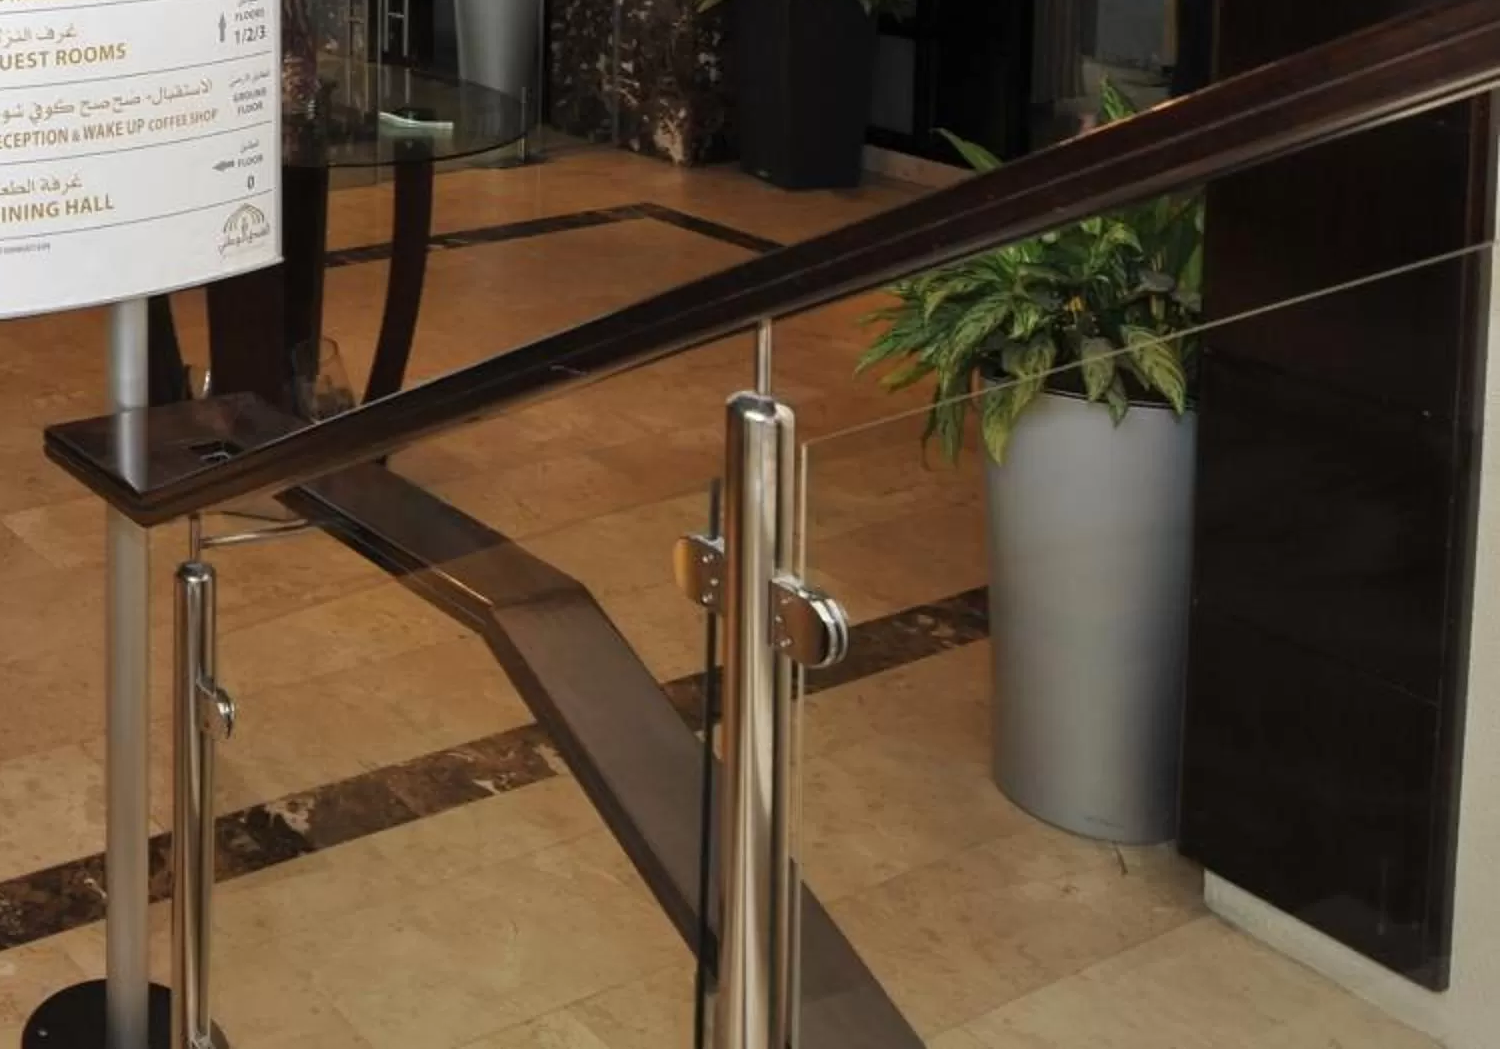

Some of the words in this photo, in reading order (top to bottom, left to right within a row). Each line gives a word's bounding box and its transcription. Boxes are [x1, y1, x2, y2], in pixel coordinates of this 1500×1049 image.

[234, 24, 267, 46] 1/2/3
[55, 42, 127, 66] ROOMS
[236, 100, 264, 116] FLOOR
[83, 120, 124, 141] WAKE
[127, 117, 146, 135] UP
[147, 113, 188, 132] COFFEE
[189, 107, 219, 126] SHOP
[236, 153, 264, 168] FLOOR
[247, 174, 256, 190] 0
[64, 192, 116, 216] HALL
